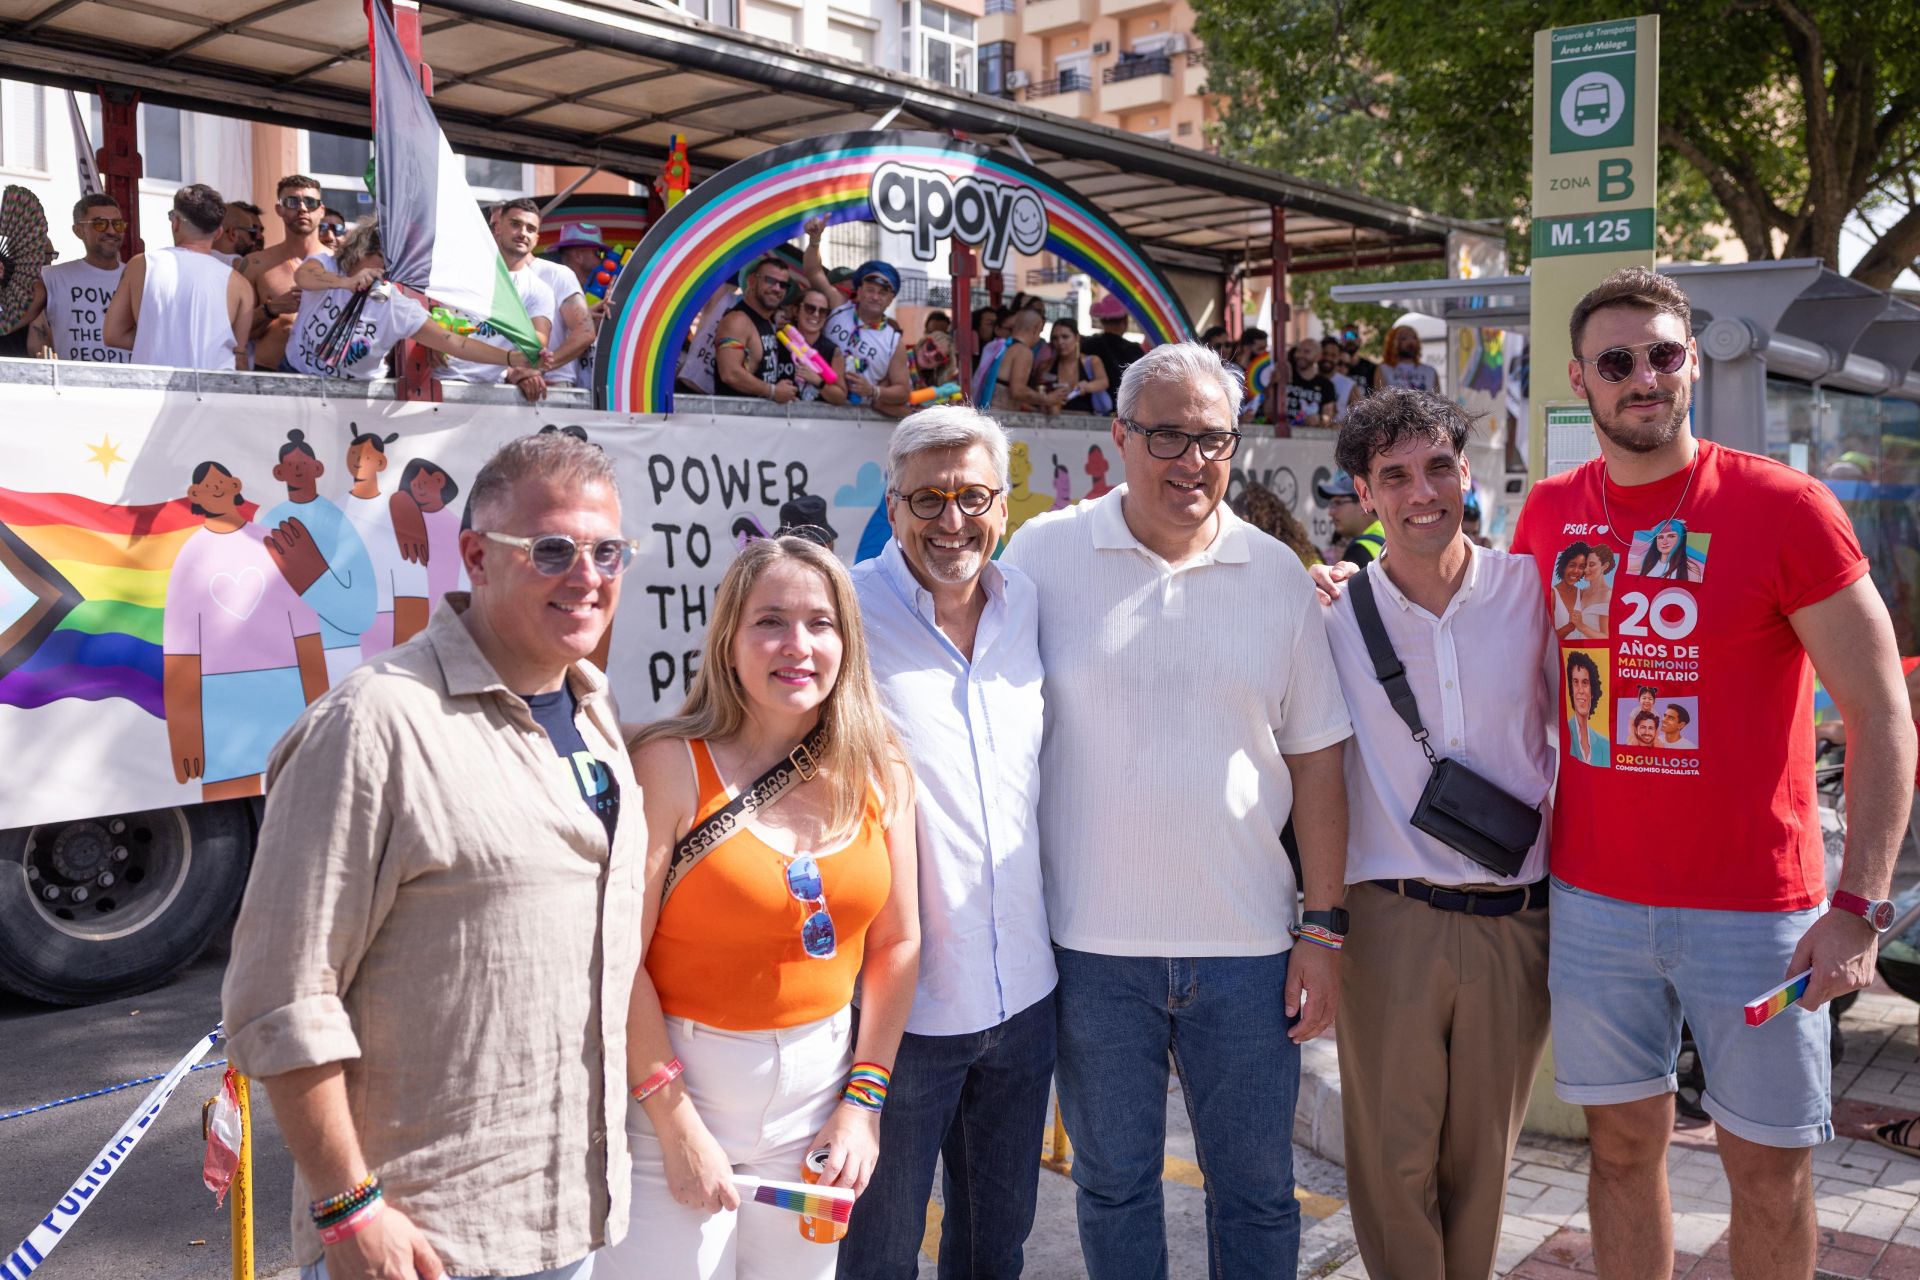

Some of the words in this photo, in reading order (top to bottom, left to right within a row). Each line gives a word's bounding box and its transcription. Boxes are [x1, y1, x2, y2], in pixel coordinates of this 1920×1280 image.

[1552, 32, 1584, 42] Consorcio
[1585, 30, 1594, 38] de
[1596, 25, 1637, 36] Transportes
[1560, 44, 1580, 55] Área
[1582, 43, 1593, 52] de
[1594, 40, 1628, 51] Málaga
[1550, 176, 1591, 191] ZONA
[1598, 158, 1635, 203] B
[1551, 218, 1631, 246] M.125
[71, 286, 116, 305] POW
[71, 309, 96, 324] TO
[69, 328, 102, 342] THE
[648, 453, 809, 510] POWER
[1562, 523, 1588, 535] PSOE
[651, 522, 711, 569] TO
[646, 583, 720, 633] TH
[1618, 588, 1698, 640] 20
[1618, 640, 1668, 658] AÑOS
[1673, 645, 1699, 659] DE
[1618, 657, 1699, 670] MATRIMONIO
[1618, 668, 1699, 682] IGUALITARIO
[1615, 764, 1661, 773] COMPROMISO
[1661, 768, 1700, 776] SOCIALISTA
[1616, 753, 1700, 768] ORGULLOSO
[742, 769, 790, 814] GUESS
[679, 811, 736, 863] GUESS
